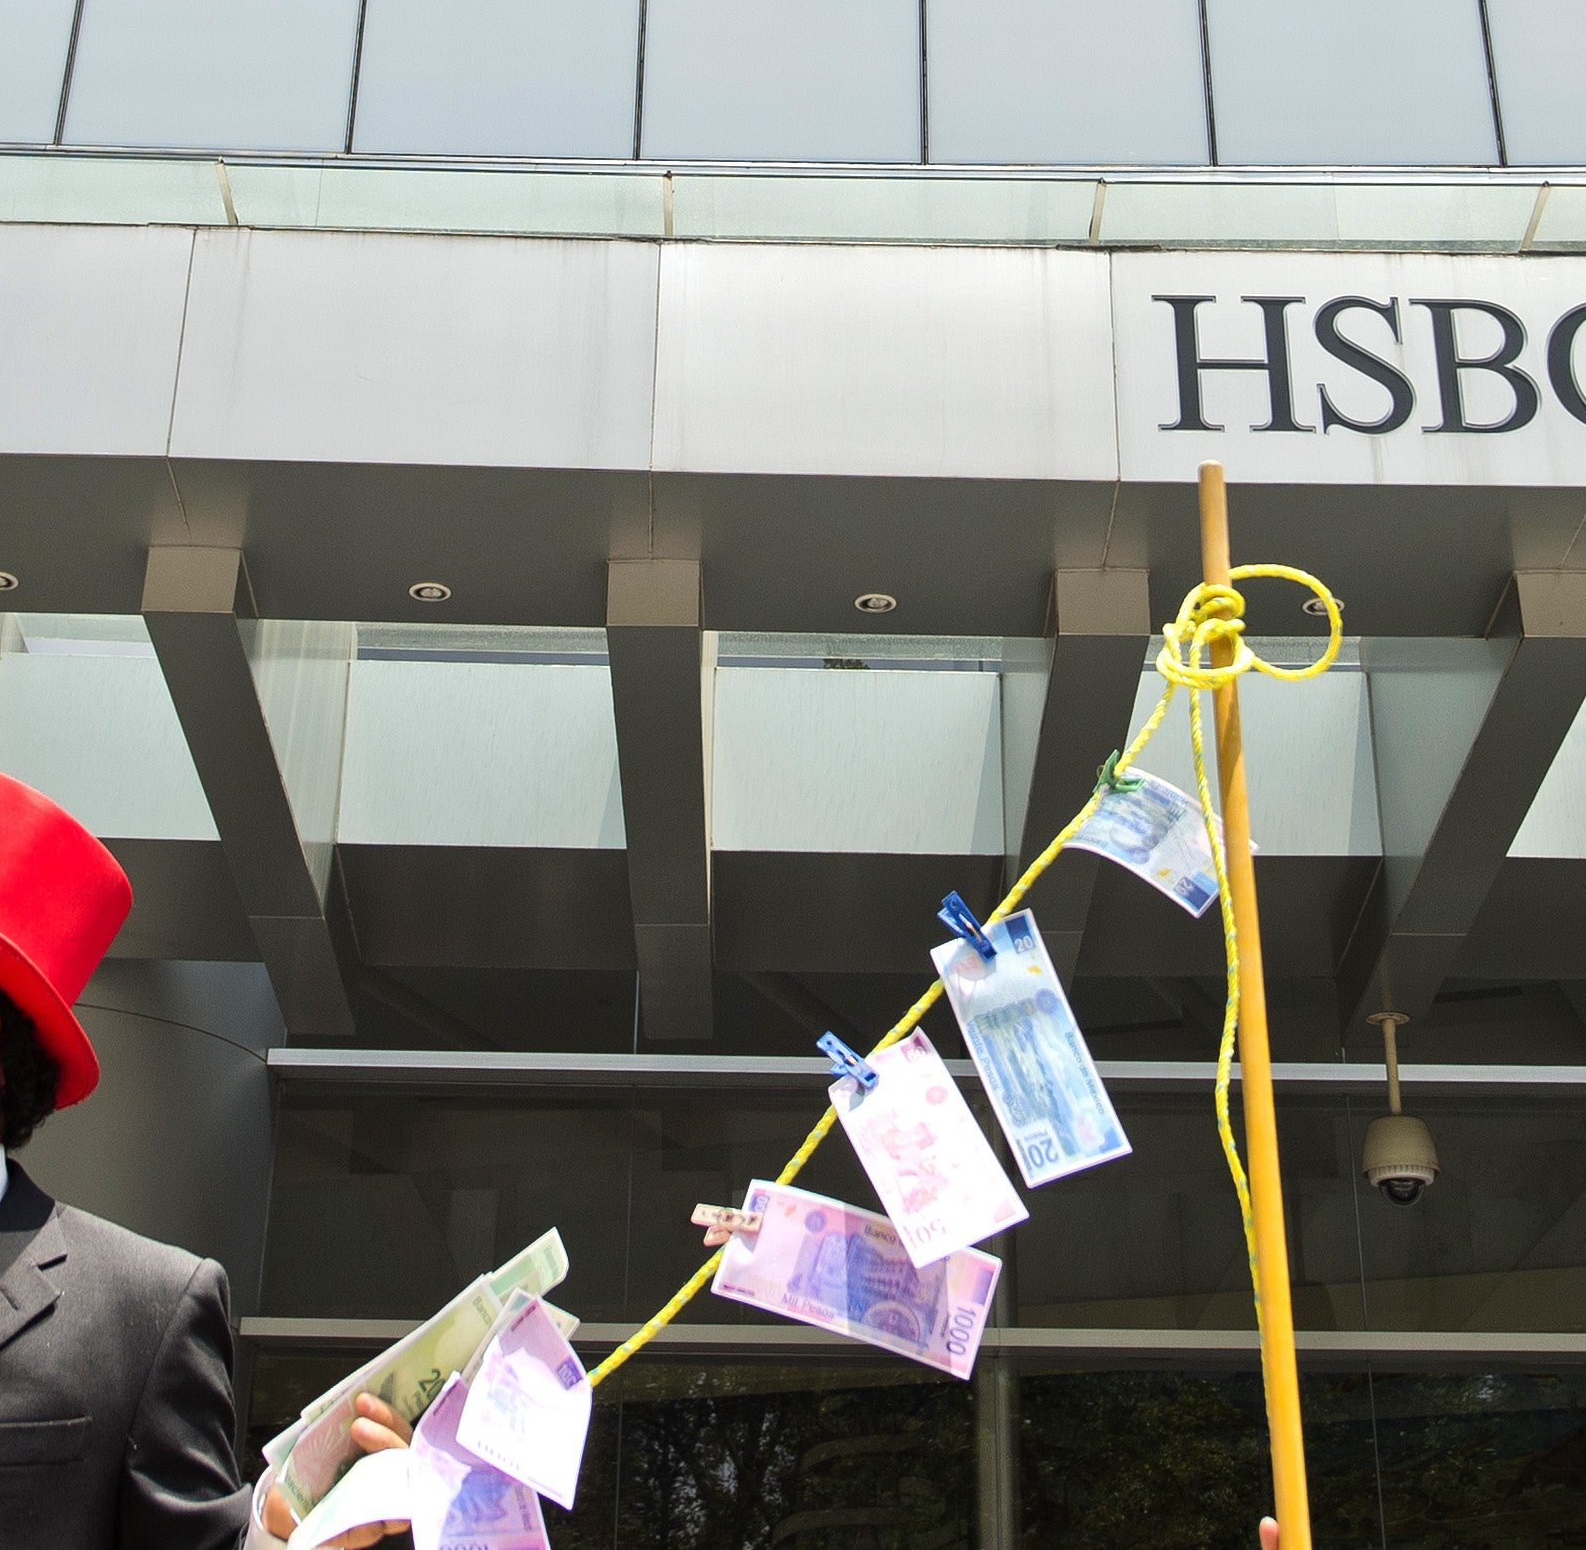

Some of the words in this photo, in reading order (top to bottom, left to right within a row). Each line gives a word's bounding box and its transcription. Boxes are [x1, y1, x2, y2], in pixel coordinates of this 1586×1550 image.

[1012, 933, 1035, 953] 20
[966, 1019, 985, 1054] Veinte
[979, 1056, 999, 1090] Pesos
[1064, 1030, 1082, 1063] Banco
[1078, 1063, 1090, 1077] de
[1026, 1137, 1060, 1169] 20
[862, 1223, 897, 1244] Banco
[912, 1216, 947, 1245] 50
[780, 1292, 798, 1307] Mil
[801, 1299, 835, 1318] Pesos
[944, 1305, 976, 1357] 1000
